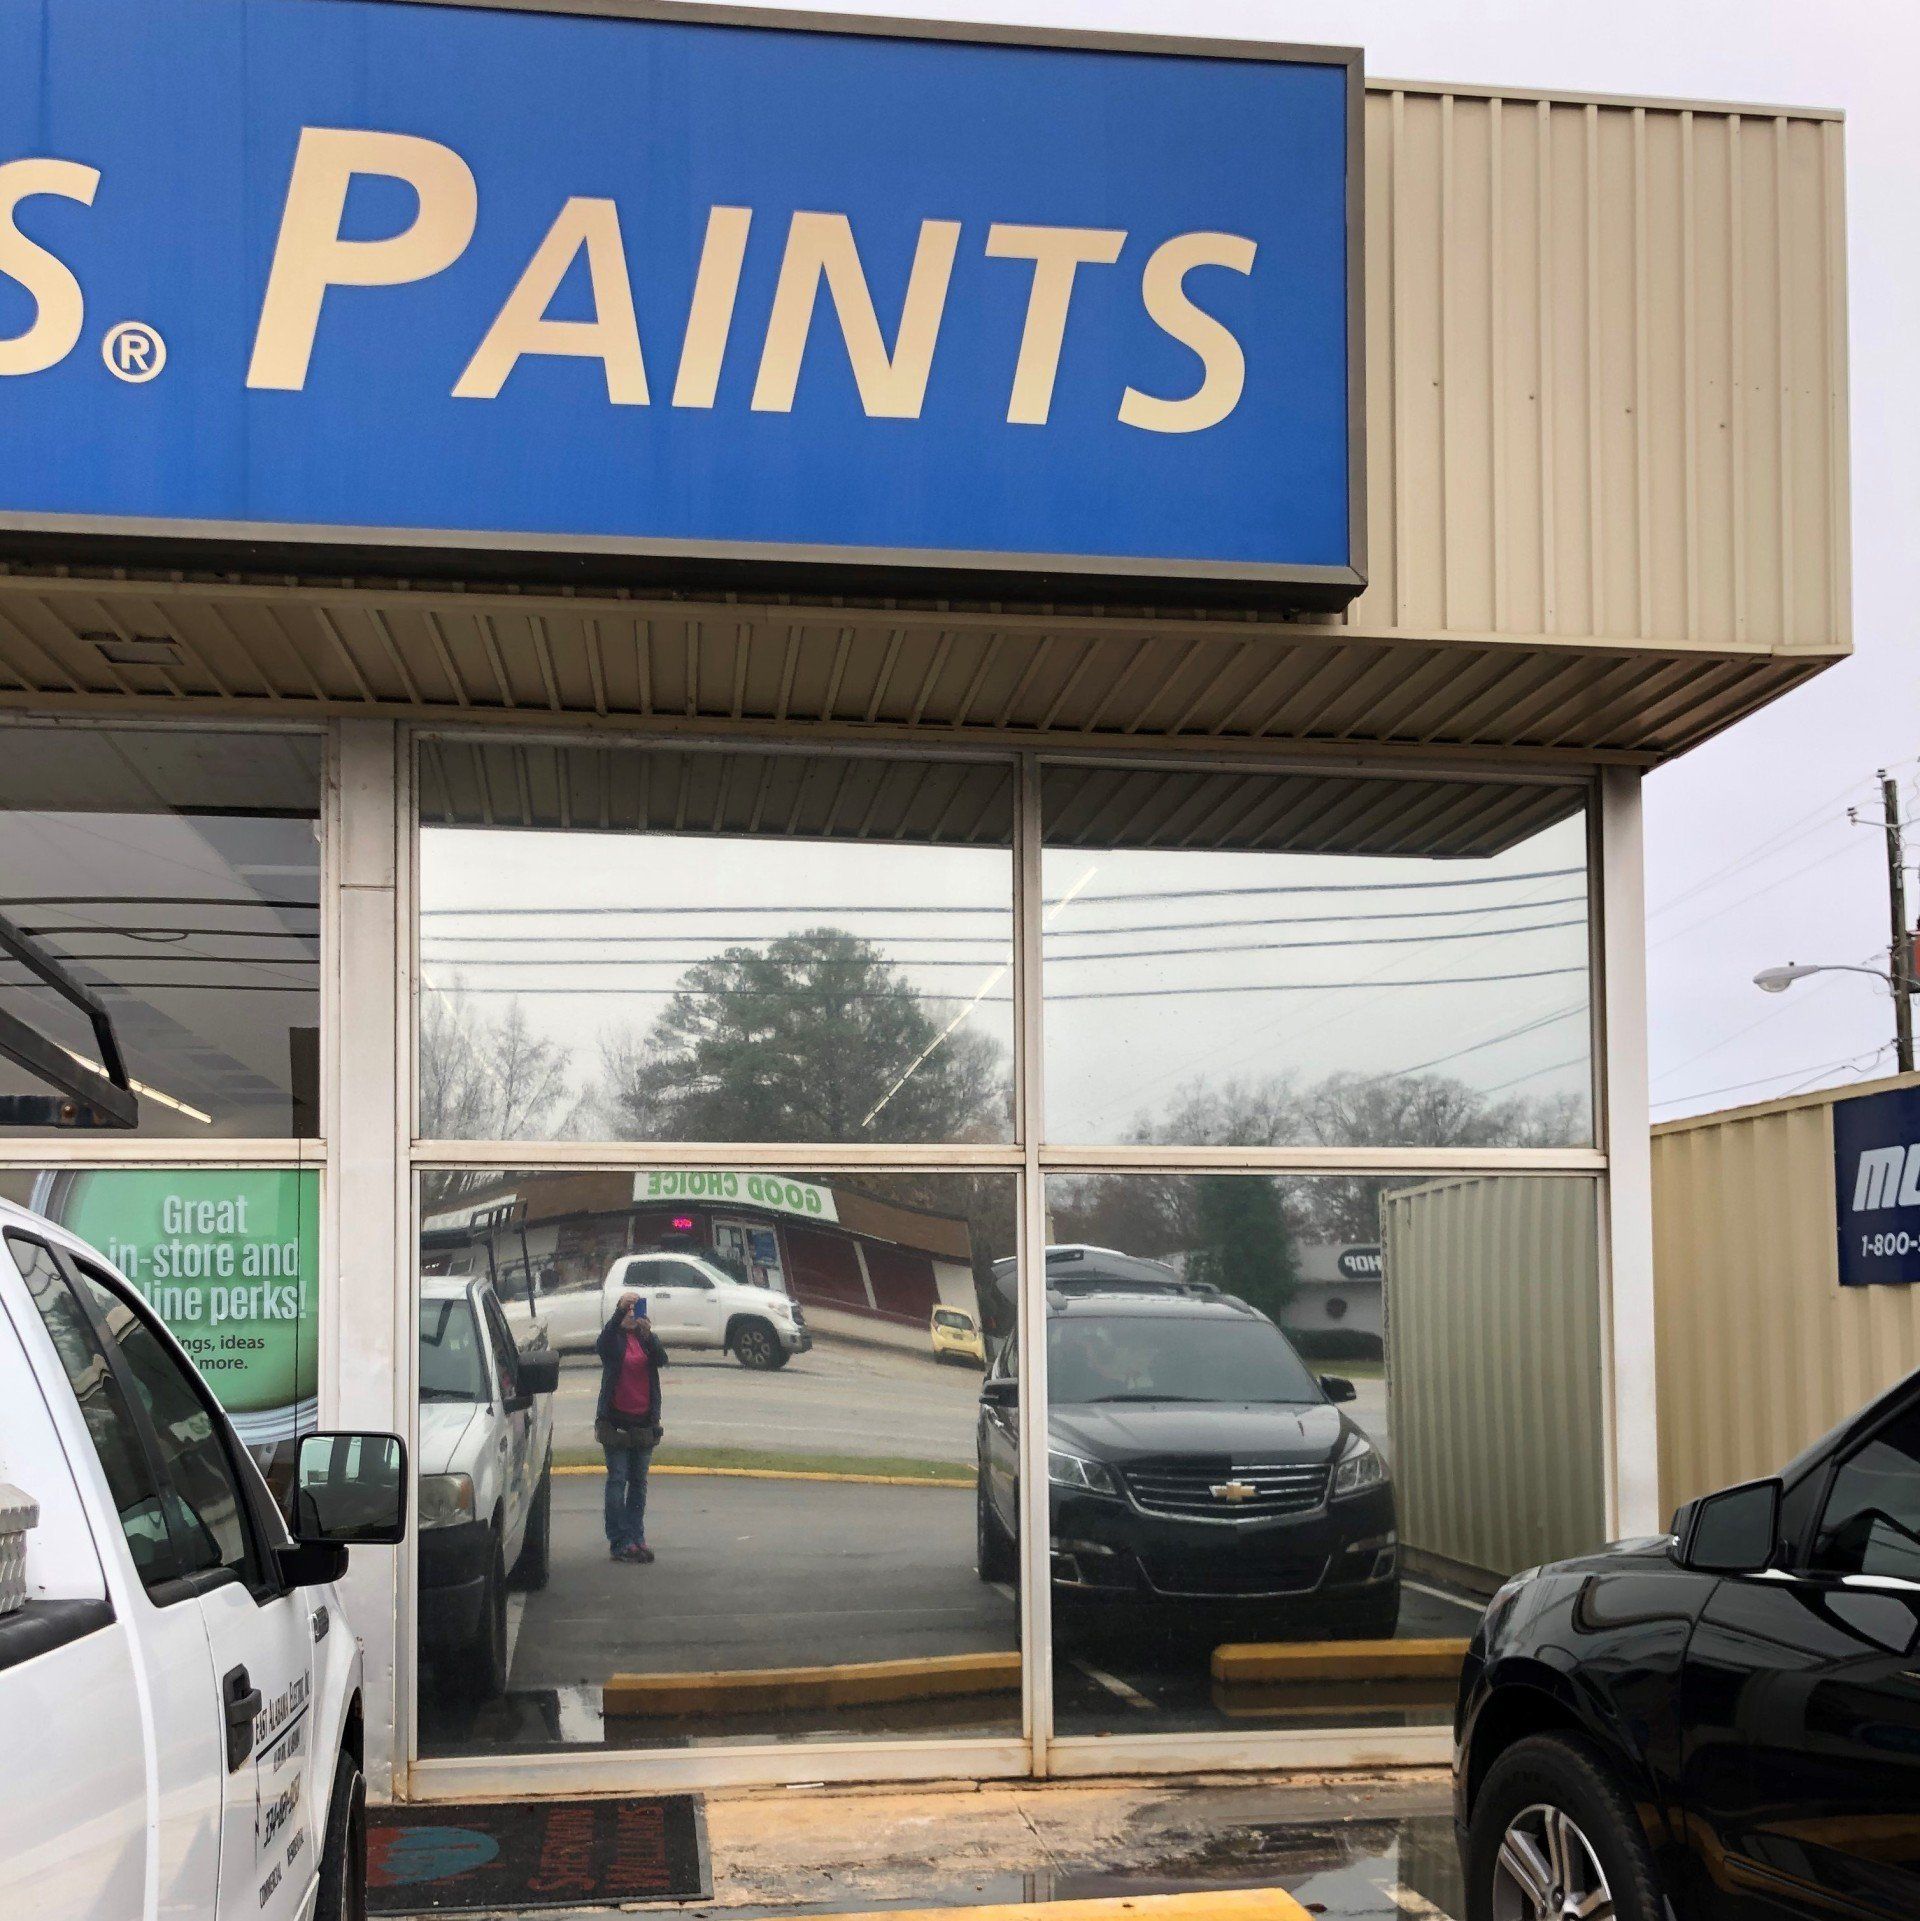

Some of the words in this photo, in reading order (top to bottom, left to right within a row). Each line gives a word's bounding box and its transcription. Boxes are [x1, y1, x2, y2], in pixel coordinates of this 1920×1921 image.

[246, 126, 1258, 434] PAINTS
[163, 1194, 249, 1234] Great
[108, 1236, 235, 1278] in-store
[242, 1238, 299, 1278] and
[1862, 1231, 1920, 1257] 1-800-
[210, 1280, 308, 1325] perks!
[220, 1335, 265, 1349] ideas
[199, 1358, 249, 1370] more.
